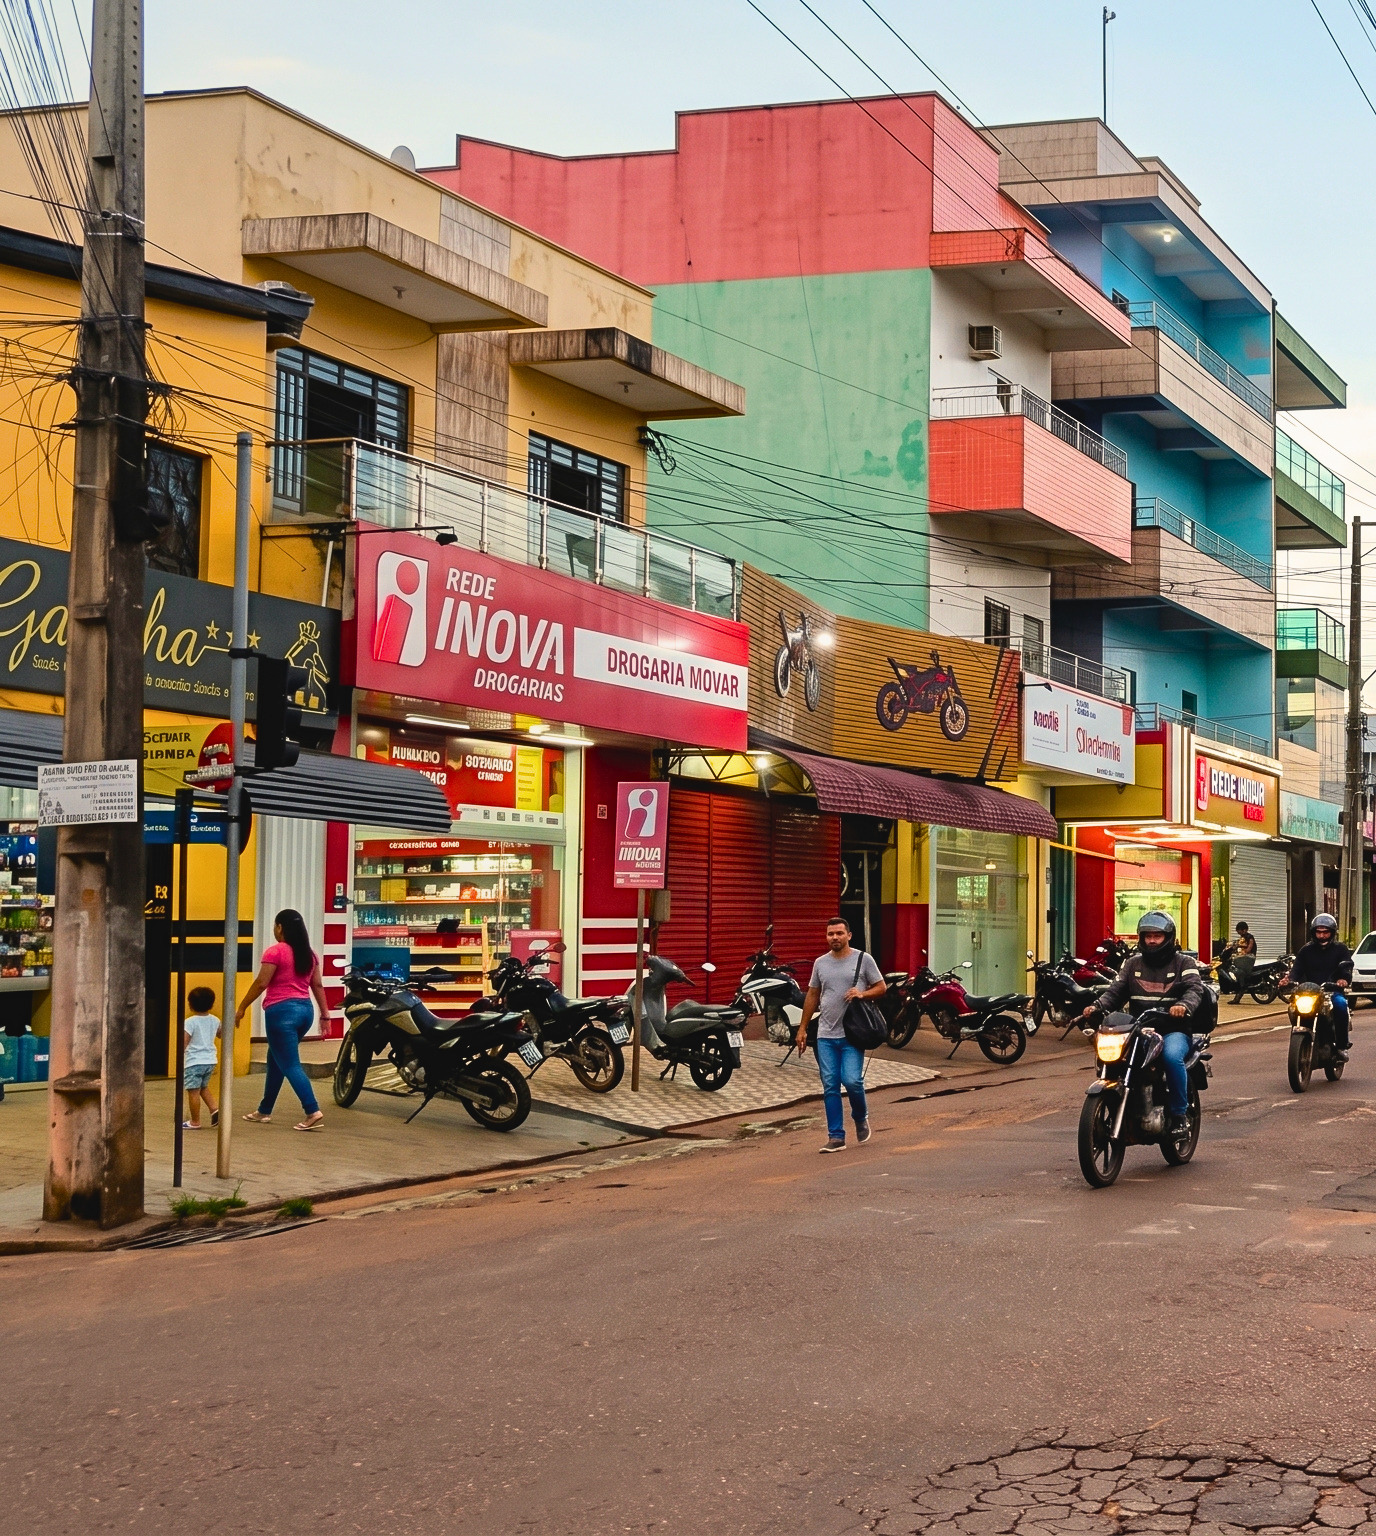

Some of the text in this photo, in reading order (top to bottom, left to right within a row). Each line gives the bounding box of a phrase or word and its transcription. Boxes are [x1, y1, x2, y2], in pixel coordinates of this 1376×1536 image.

[446, 567, 497, 600] REDE
[434, 597, 565, 675] INOVA
[473, 668, 565, 702] DROGARIAS
[607, 647, 739, 698] DROGARIA MOVAR
[1210, 767, 1237, 801] REDE
